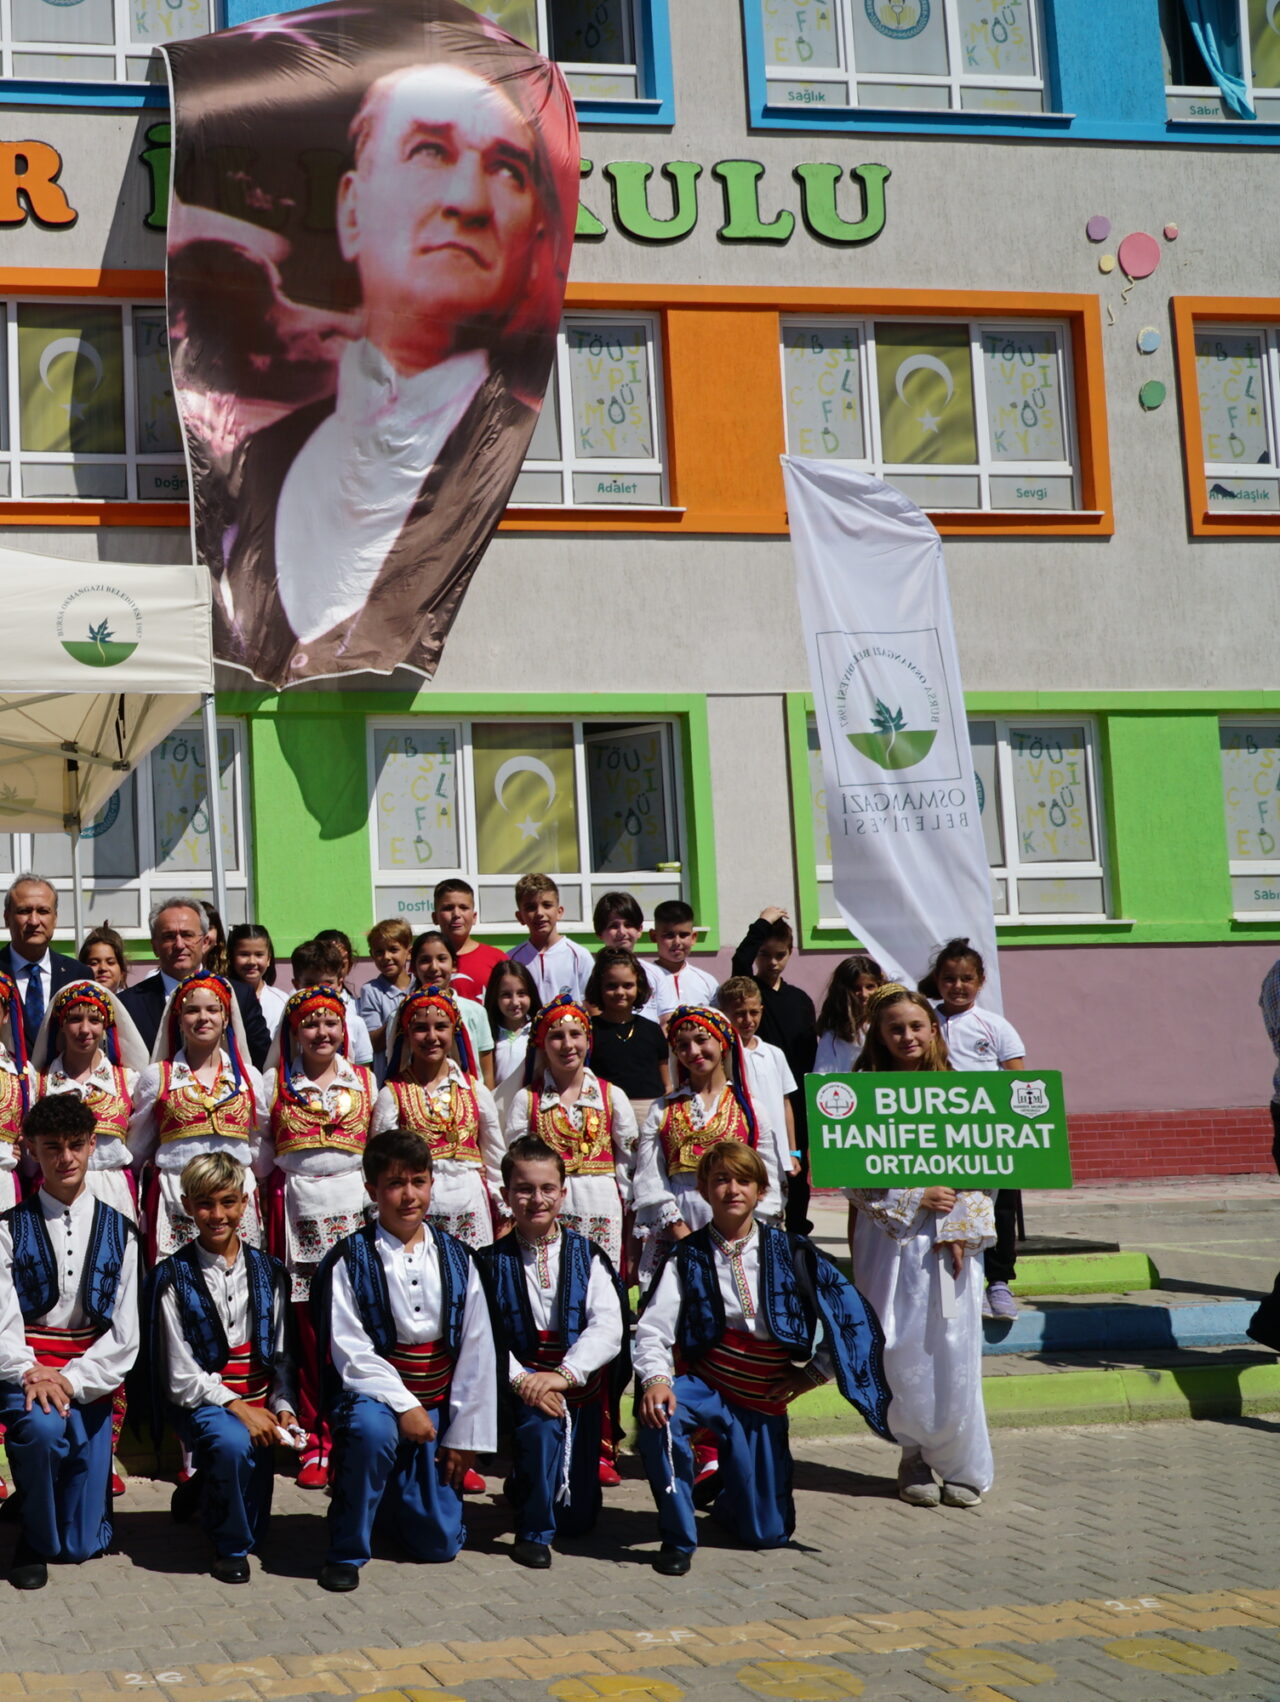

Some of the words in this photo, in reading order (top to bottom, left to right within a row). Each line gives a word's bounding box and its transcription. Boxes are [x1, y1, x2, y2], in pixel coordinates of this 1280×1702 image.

[788, 90, 825, 104] Sağlık
[1190, 105, 1219, 116] Sabır
[154, 475, 188, 490] Doğr
[597, 482, 637, 494] Adalet
[1016, 488, 1047, 501] Sevgi
[875, 1087, 996, 1115] BURSA
[822, 1119, 938, 1149] HANİFE
[945, 1124, 1055, 1148] MURAT
[865, 1155, 1014, 1175] ORTAOKULU
[1104, 1598, 1161, 1611] 2.E
[636, 1631, 697, 1644] 2.F
[124, 1672, 187, 1685] 2.G
